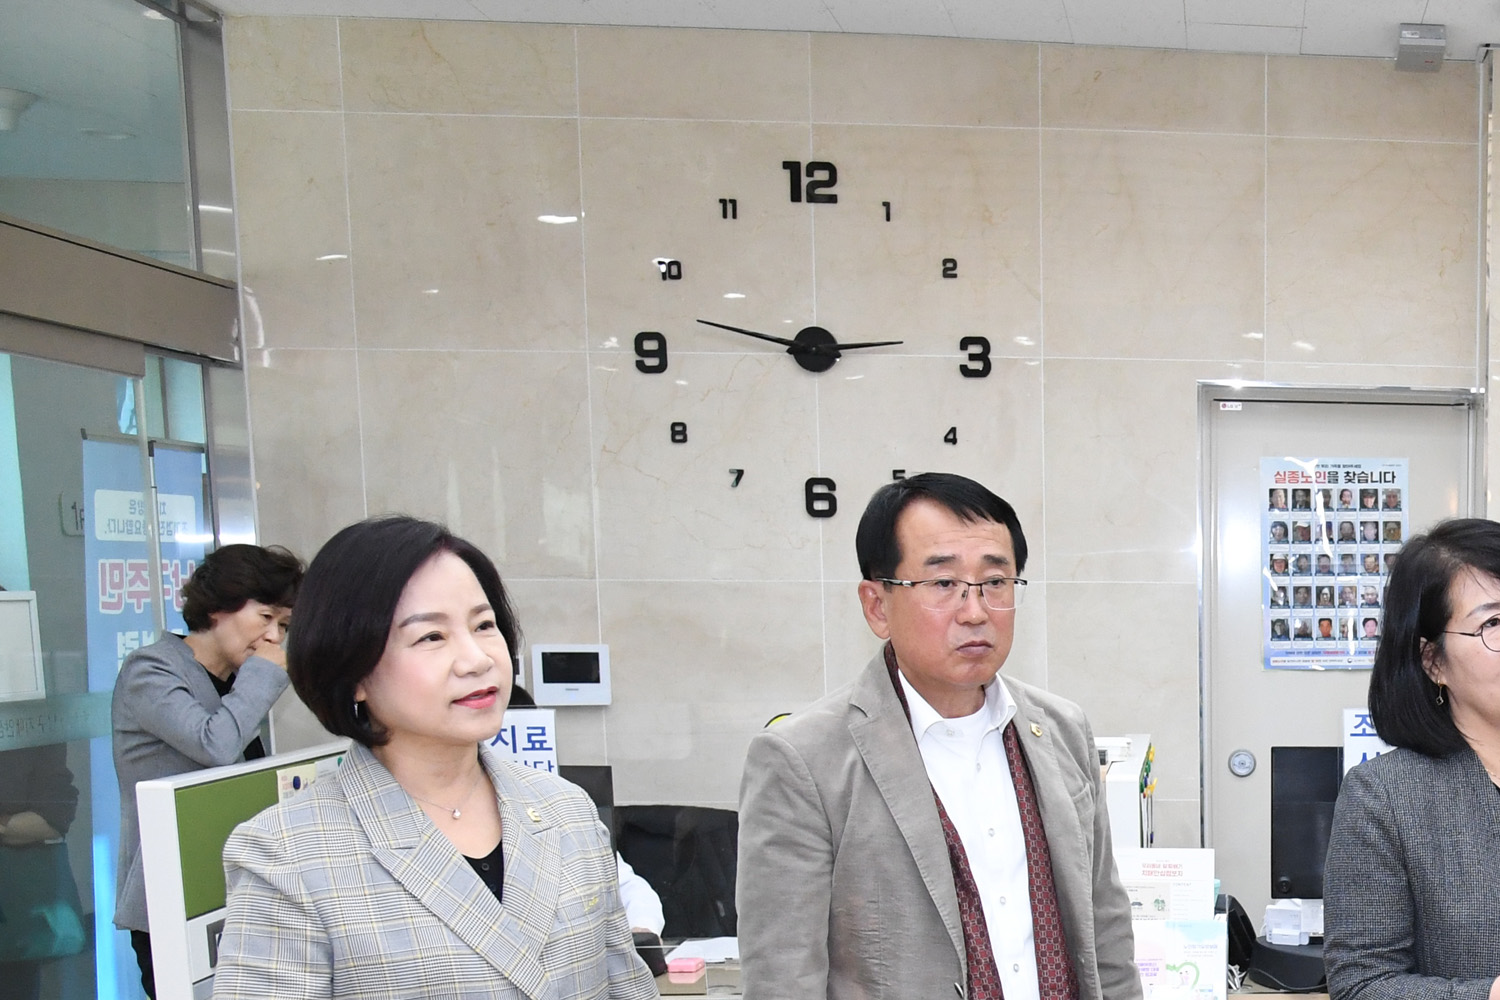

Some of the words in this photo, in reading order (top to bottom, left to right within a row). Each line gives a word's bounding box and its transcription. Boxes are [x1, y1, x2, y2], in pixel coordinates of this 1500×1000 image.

[782, 160, 838, 204] 12
[718, 198, 738, 219] 11
[882, 201, 891, 222] 1
[657, 260, 682, 281] 10
[942, 258, 958, 279] 2
[634, 331, 668, 374] 9
[959, 336, 992, 378] 3
[670, 422, 688, 443] 8
[943, 426, 958, 446] 4
[729, 469, 744, 488] 7
[1273, 470, 1340, 484] 실종노인을
[1343, 470, 1397, 485] 찾습니다
[805, 477, 837, 518] 6
